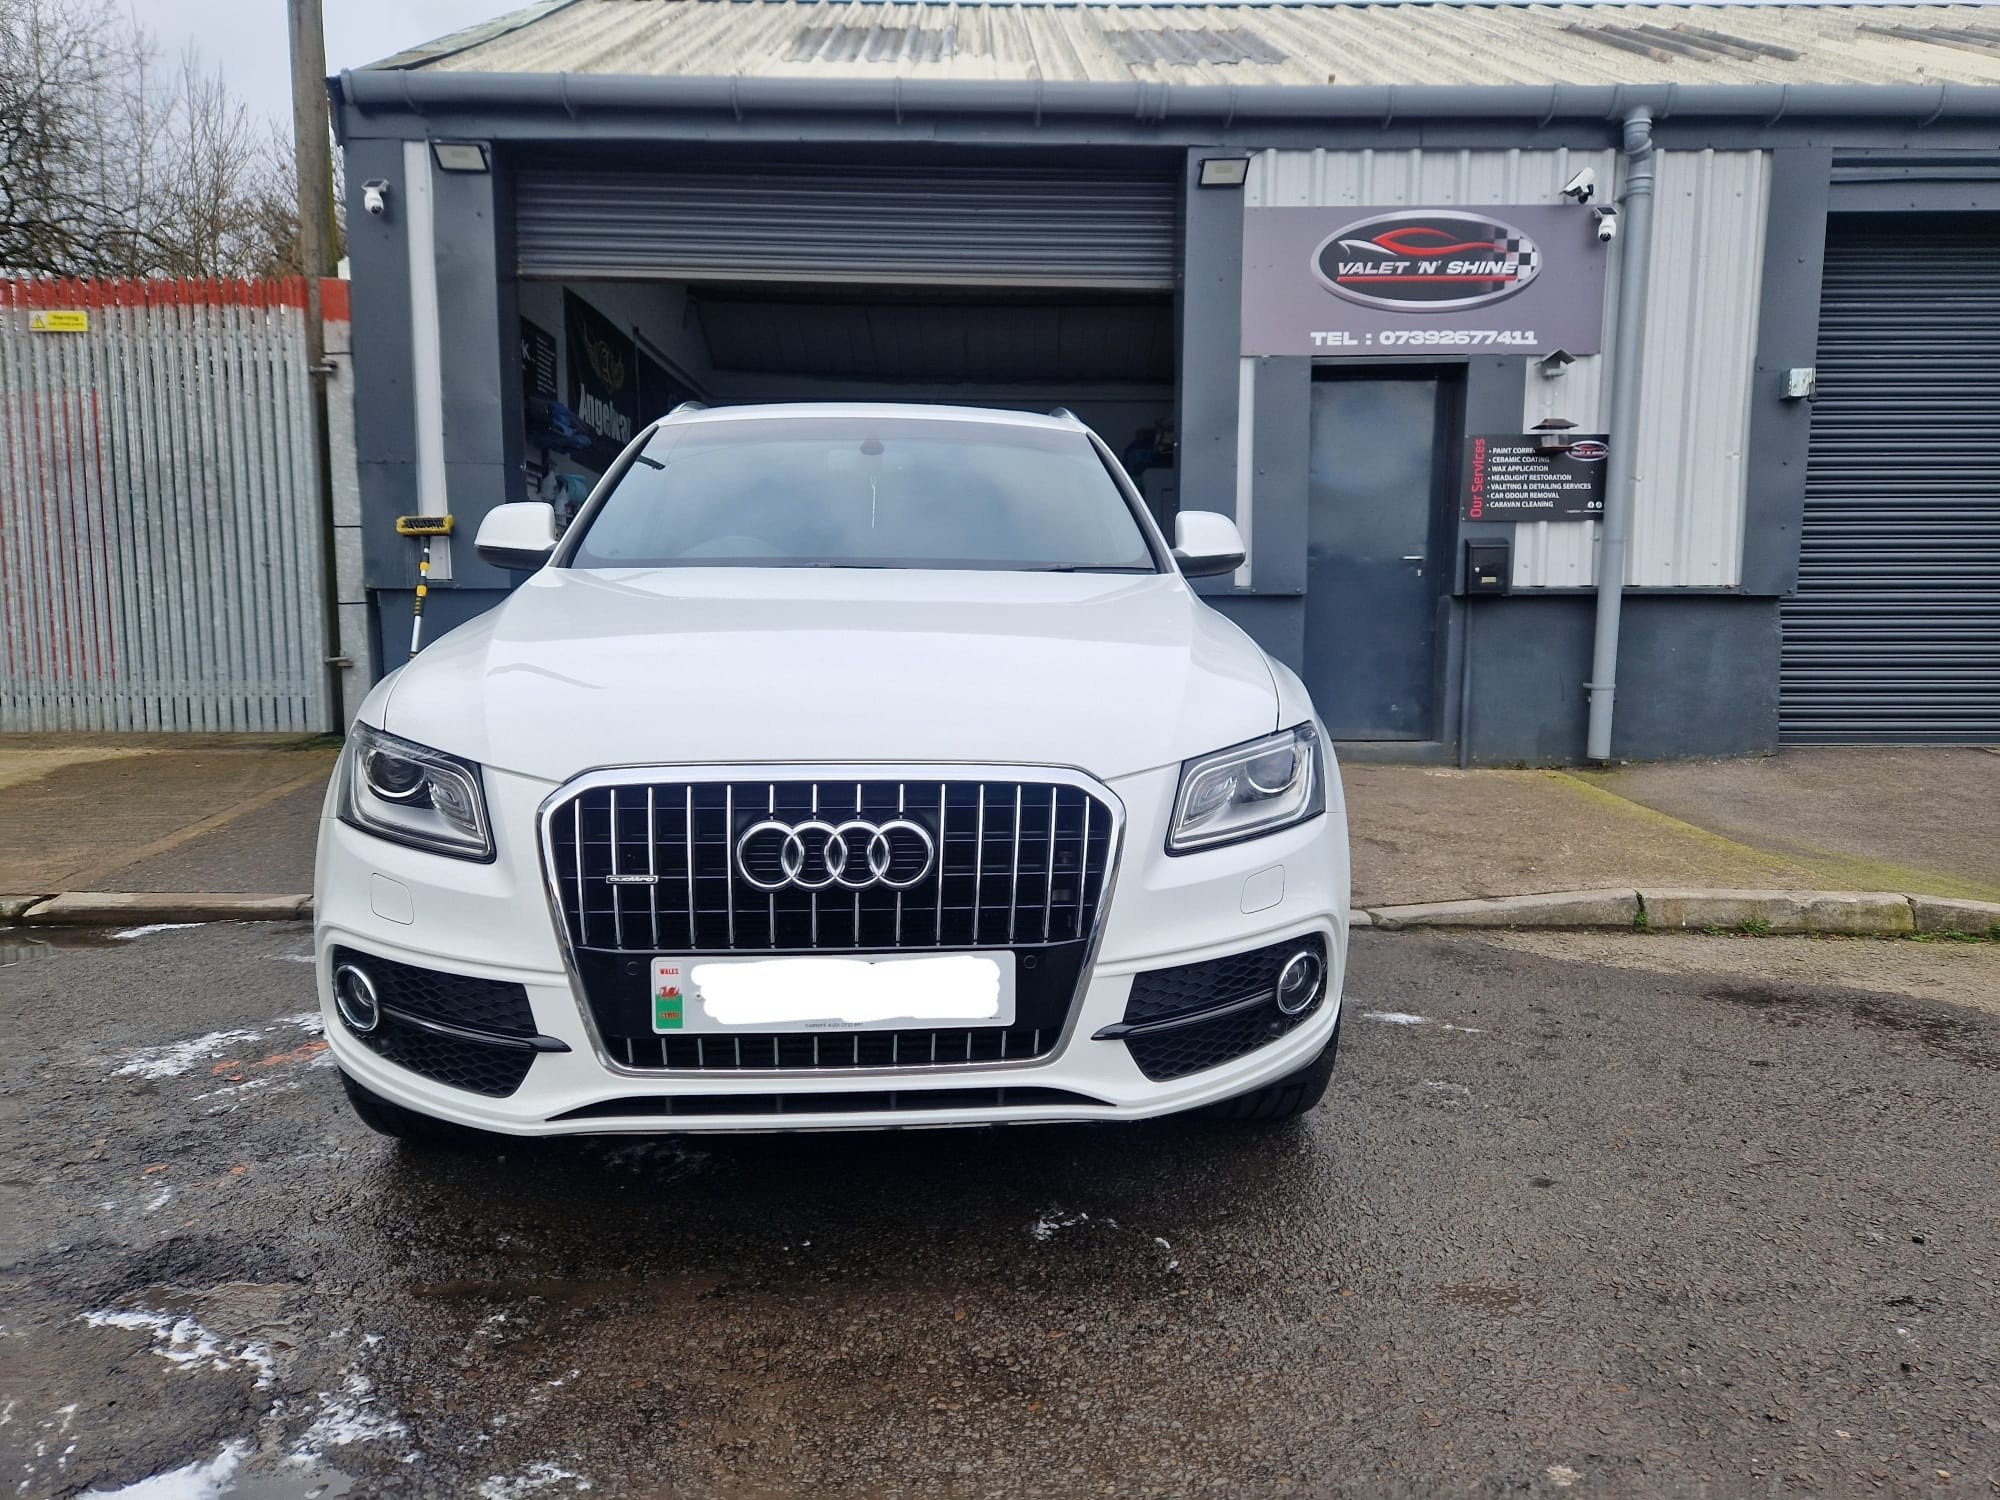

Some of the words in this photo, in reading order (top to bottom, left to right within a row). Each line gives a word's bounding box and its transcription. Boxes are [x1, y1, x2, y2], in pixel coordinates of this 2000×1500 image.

[1337, 261, 1411, 275] VALET
[1418, 260, 1442, 274] 'N'
[1446, 260, 1518, 275] SHINE
[1310, 331, 1358, 345] TEL
[1379, 330, 1538, 345] 07392677411
[1471, 438, 1485, 492] Services
[1470, 495, 1482, 517] Our
